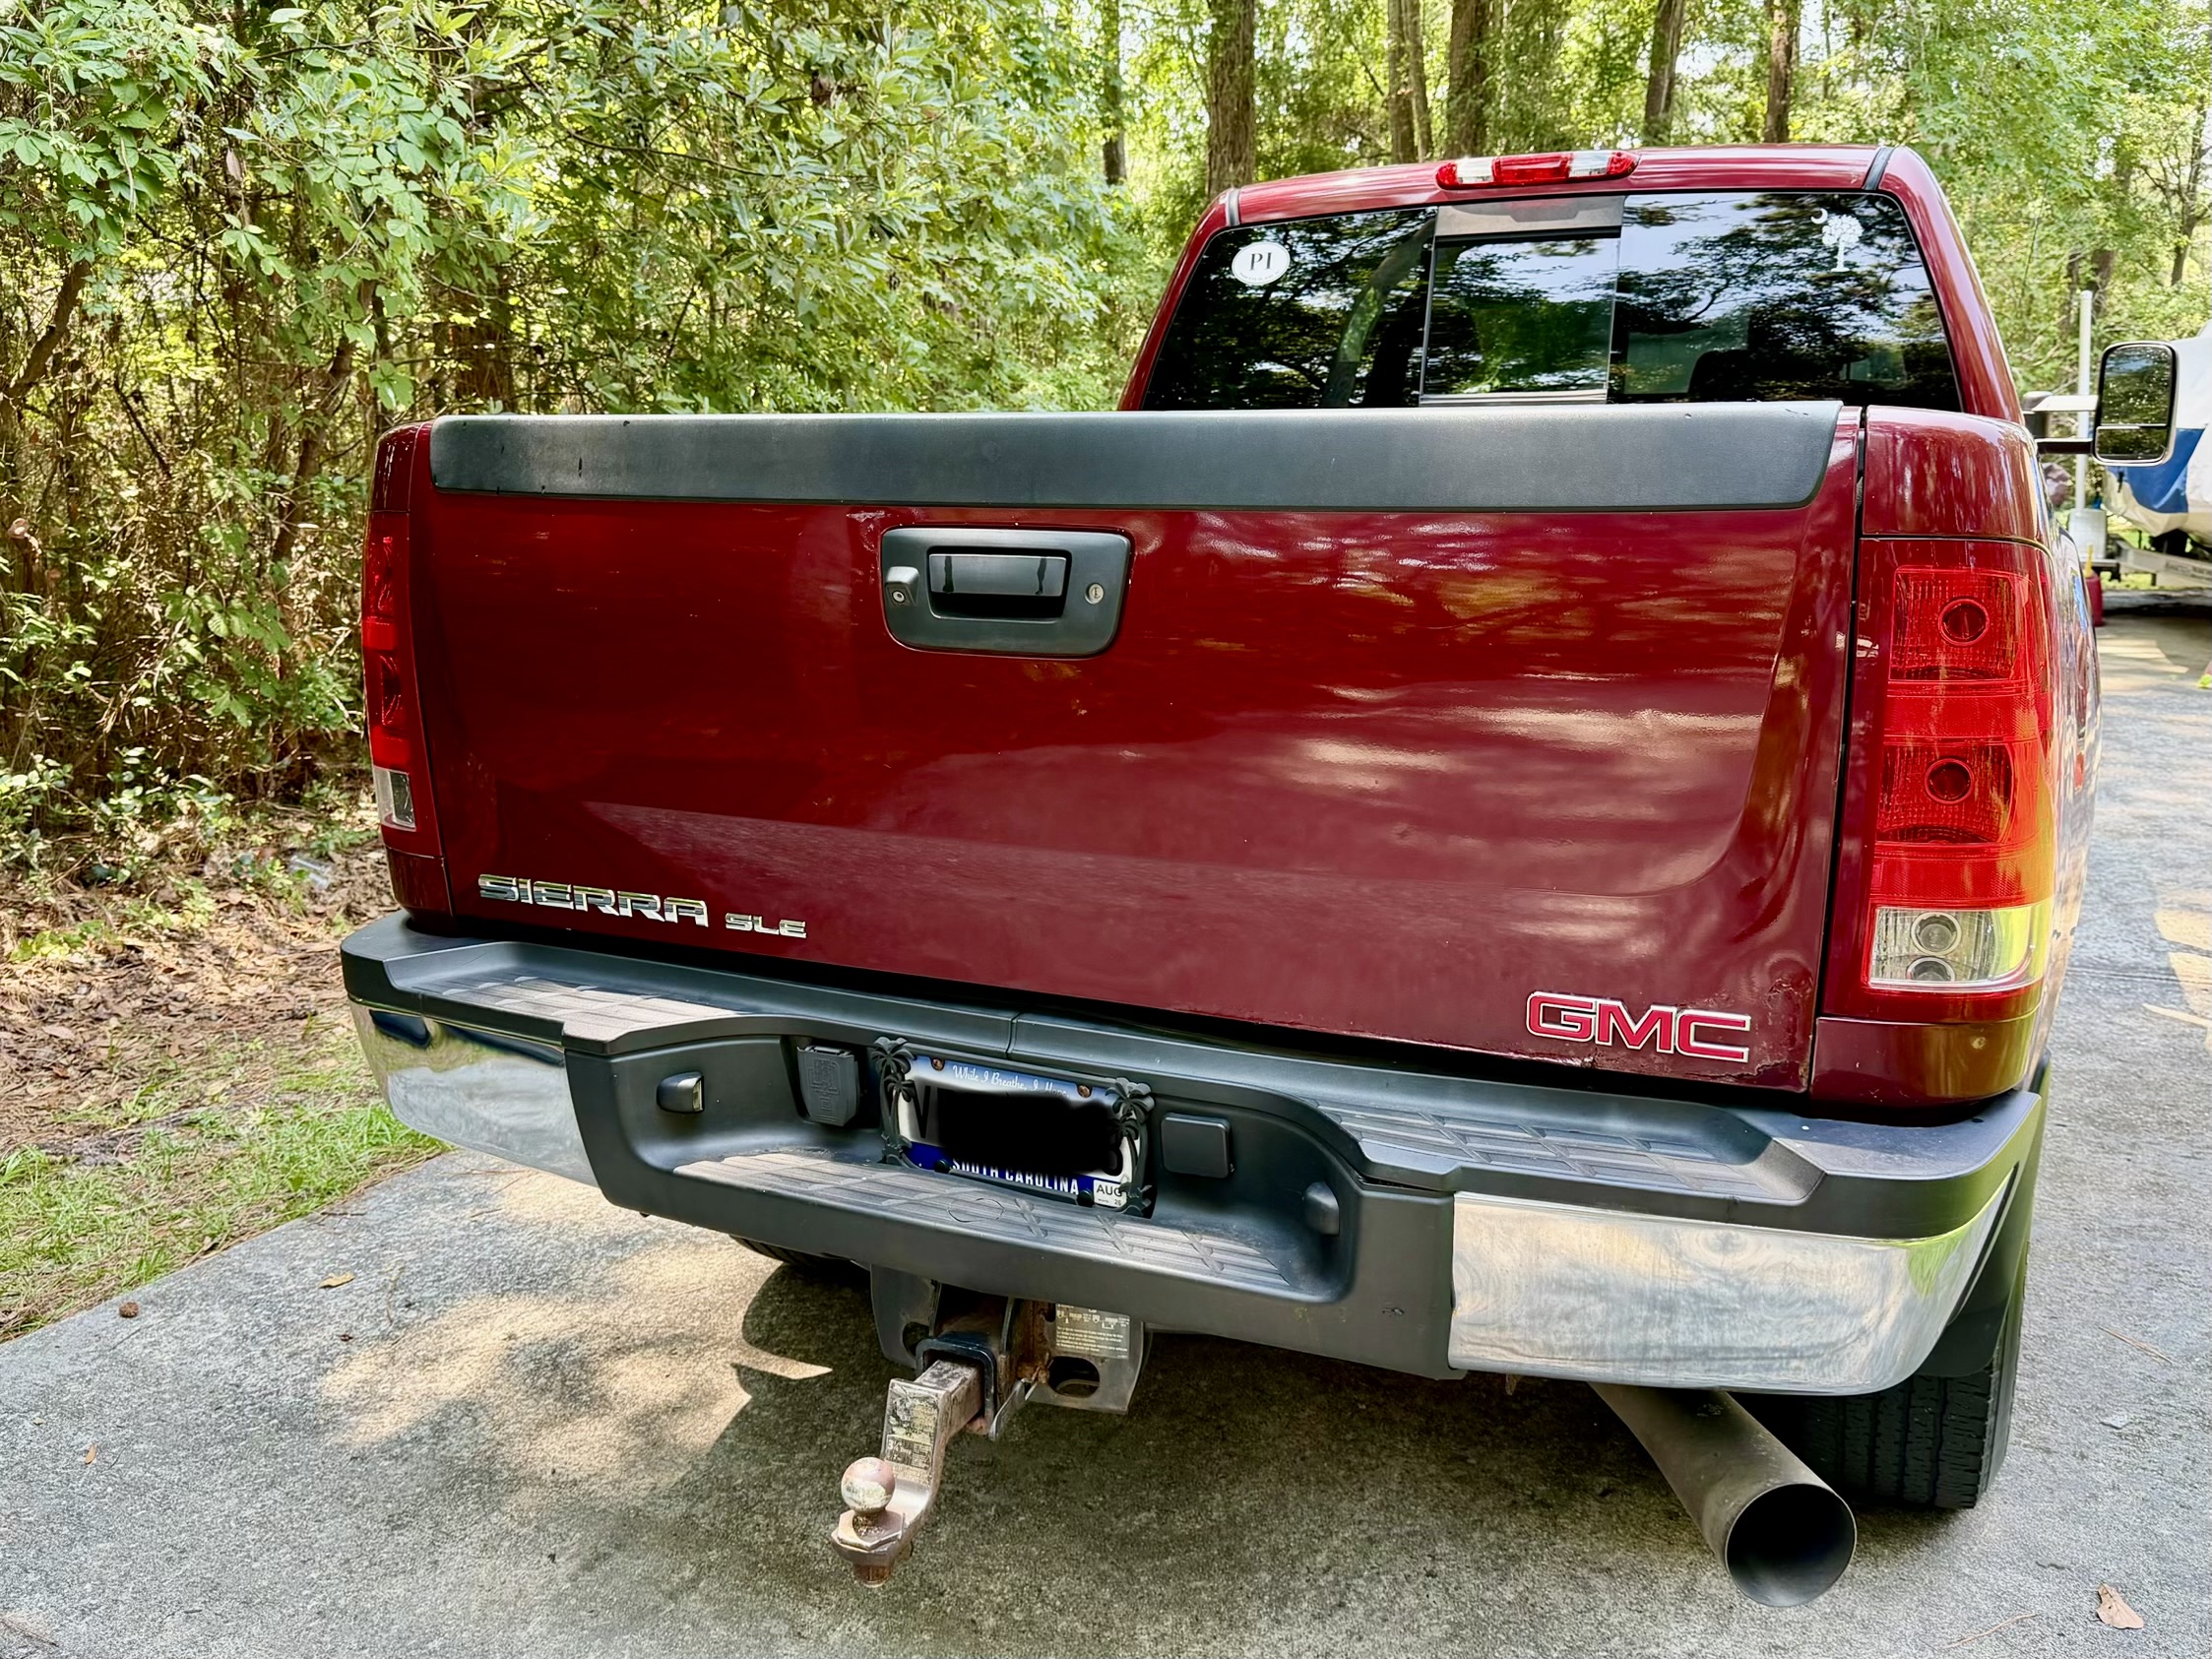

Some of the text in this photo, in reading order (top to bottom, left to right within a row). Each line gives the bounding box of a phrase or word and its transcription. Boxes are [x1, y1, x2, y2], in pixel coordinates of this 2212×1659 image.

[477, 873, 806, 939] SIERRA SLE
[1526, 990, 1751, 1063] GMC
[952, 1065, 980, 1082] While
[1005, 1168, 1080, 1195] CAROLINA
[1096, 1183, 1122, 1197] AUG
